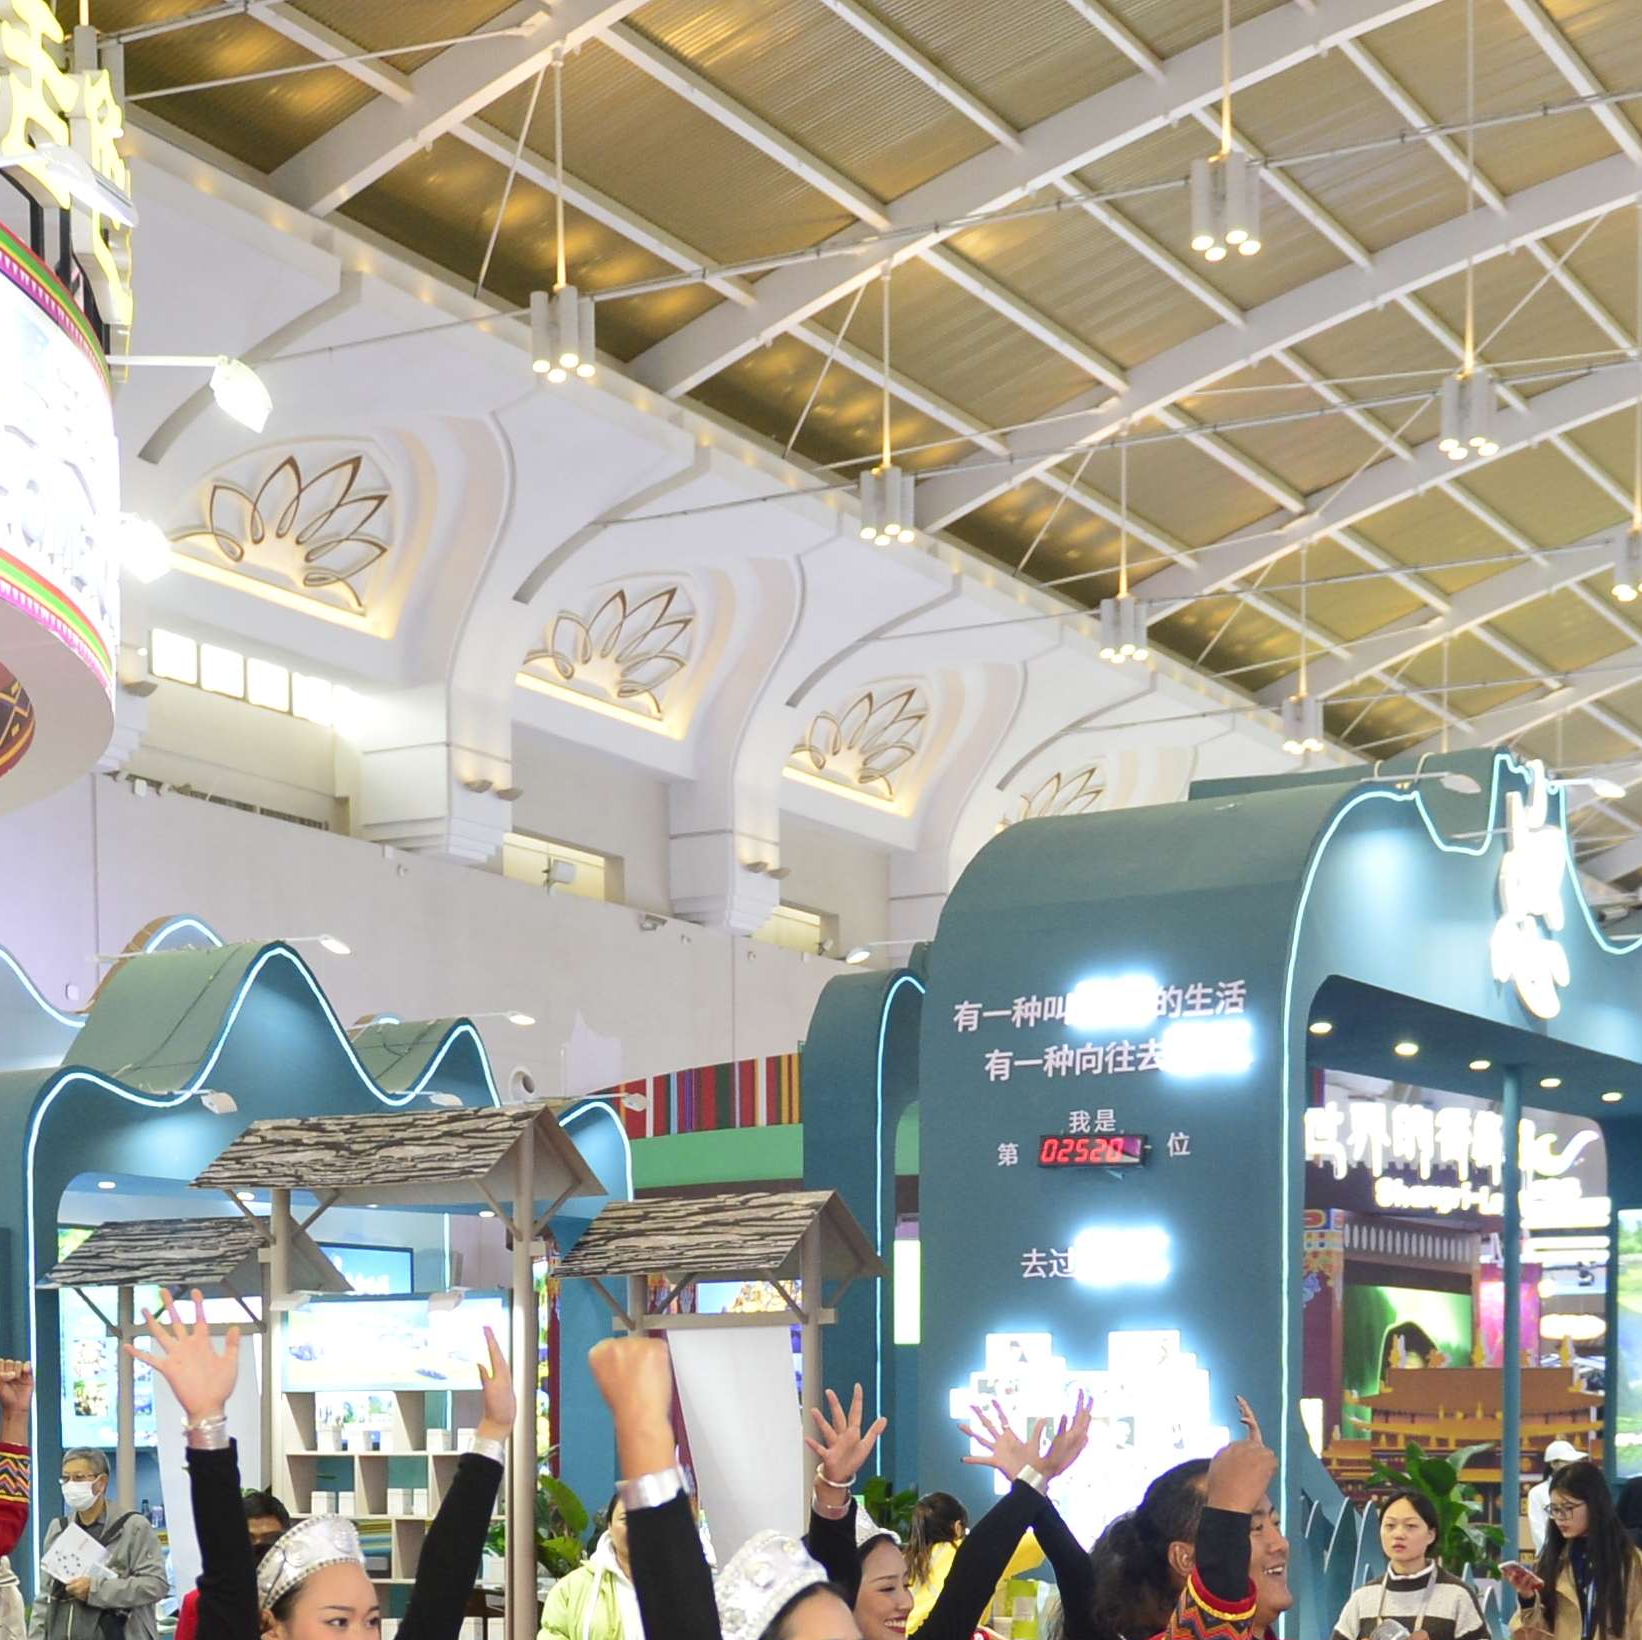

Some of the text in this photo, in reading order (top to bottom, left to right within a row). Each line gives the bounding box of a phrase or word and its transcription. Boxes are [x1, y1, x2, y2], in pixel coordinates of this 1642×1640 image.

[1068, 1108, 1117, 1135] 我是
[996, 1142, 1020, 1168] 第
[1167, 1131, 1192, 1158] 位
